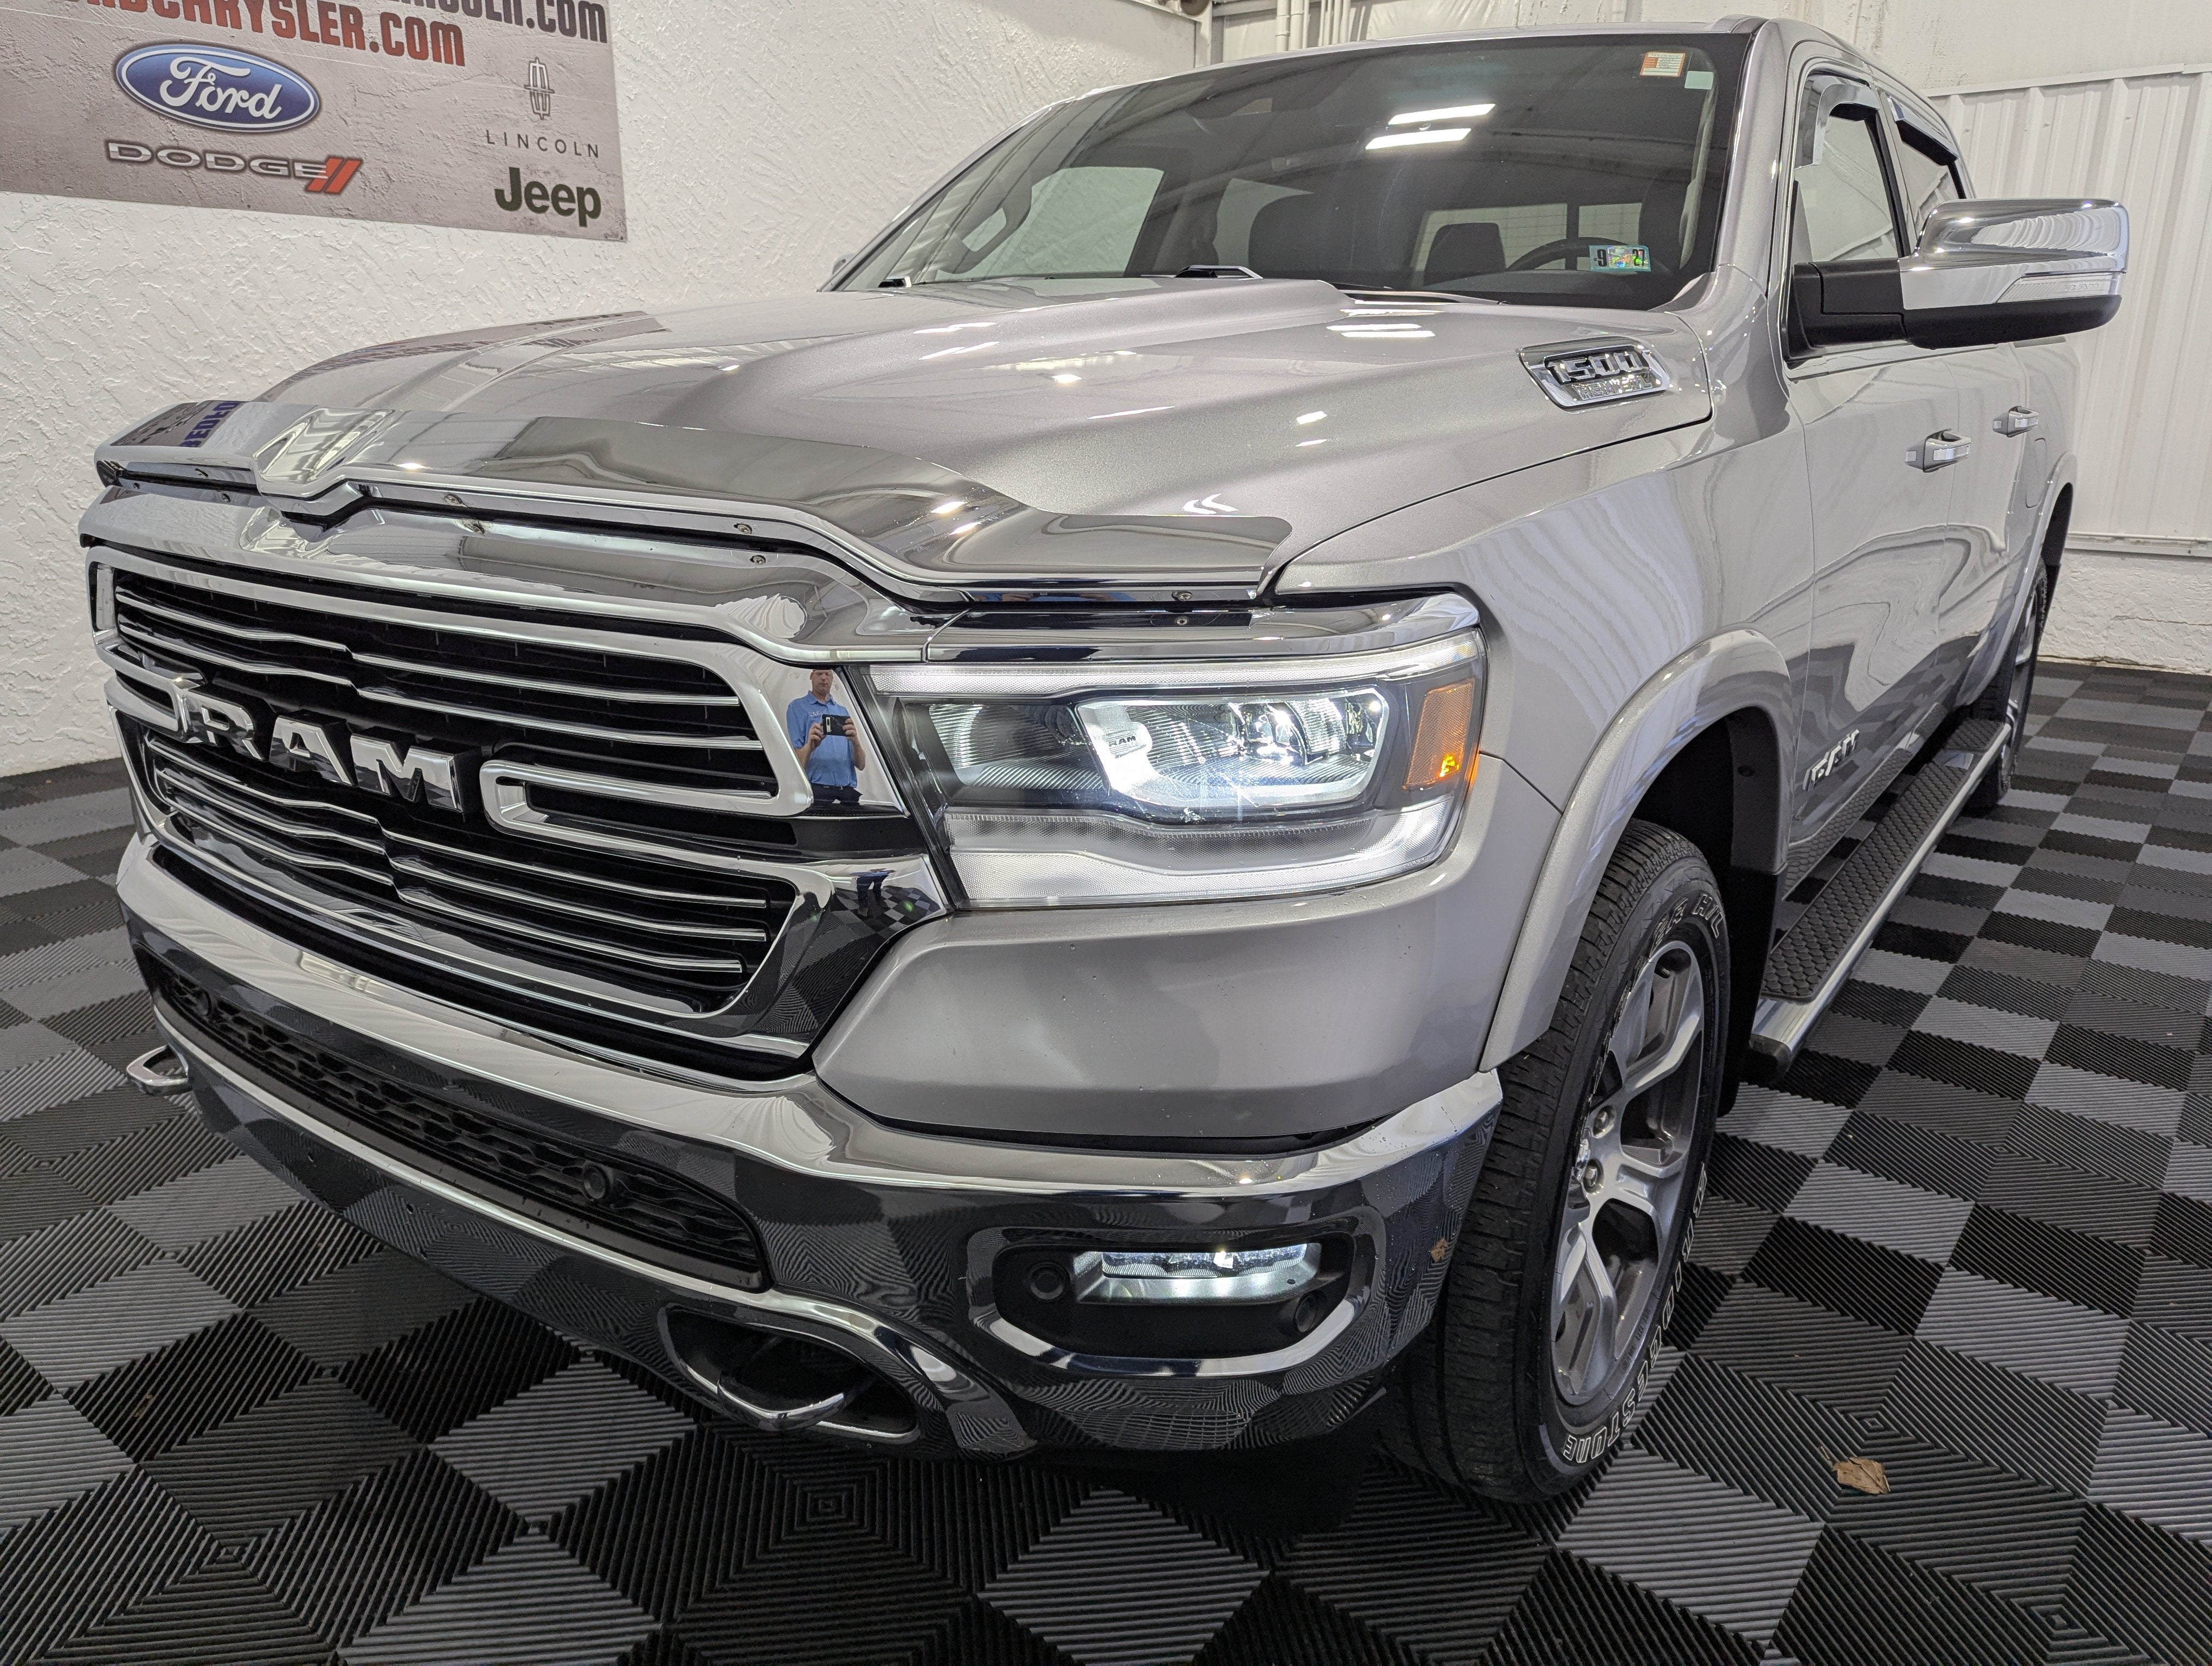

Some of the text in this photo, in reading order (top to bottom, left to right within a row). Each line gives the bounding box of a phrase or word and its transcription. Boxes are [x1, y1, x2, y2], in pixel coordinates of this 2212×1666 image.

[160, 56, 282, 120] Ford
[108, 142, 329, 179] DODGE
[486, 130, 600, 158] LINCOLN
[494, 166, 601, 227] Jeep
[1597, 249, 1607, 266] 9
[1547, 353, 1643, 382] 1500
[179, 688, 464, 813] RAM
[1108, 735, 1136, 747] RAM
